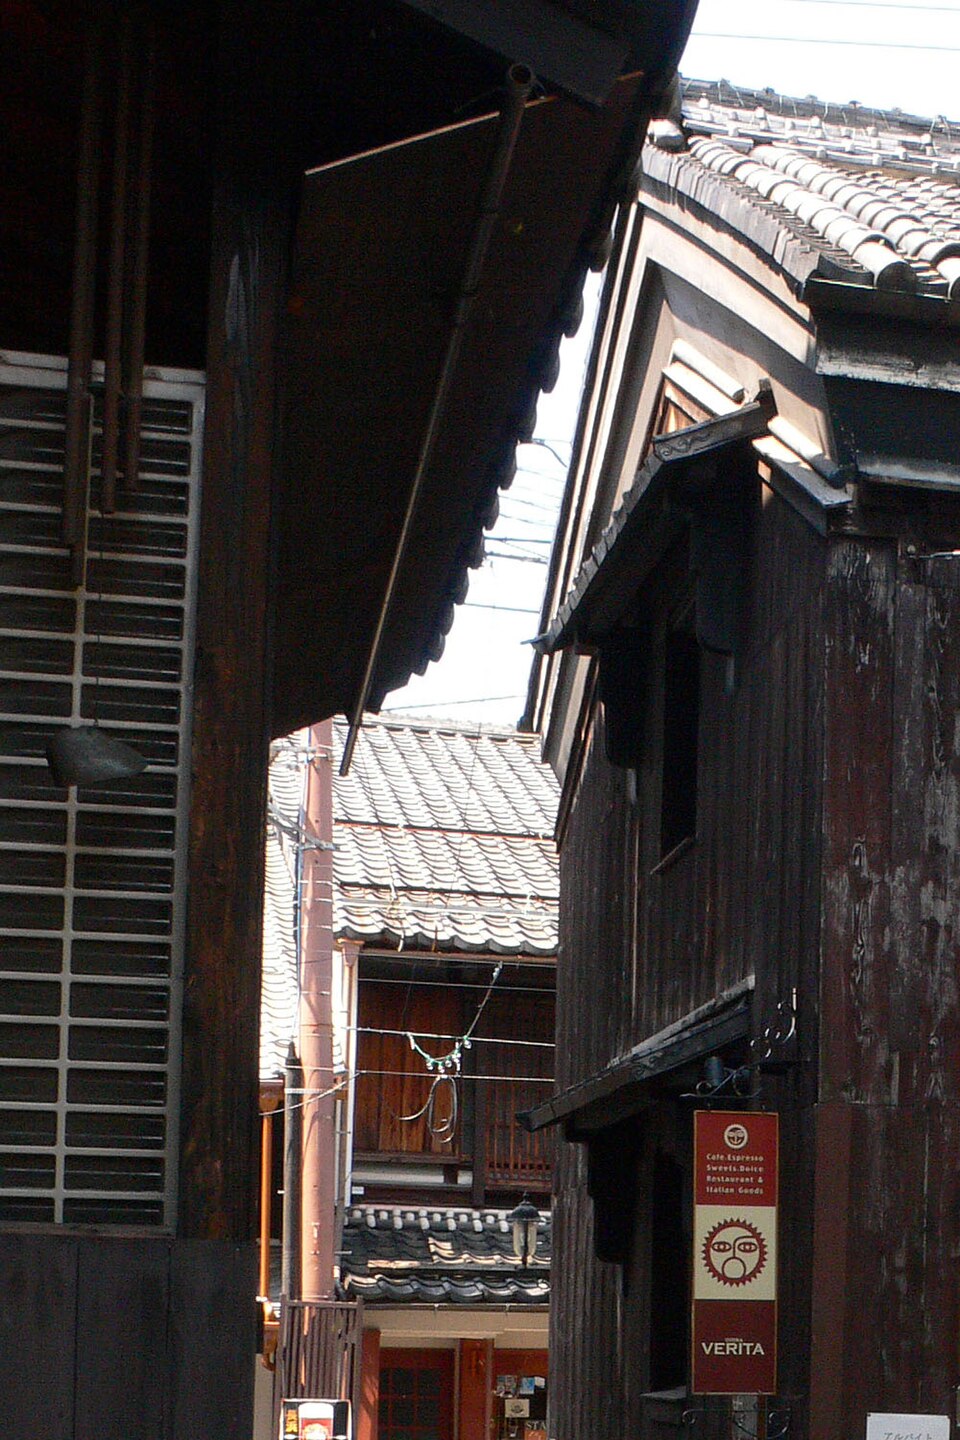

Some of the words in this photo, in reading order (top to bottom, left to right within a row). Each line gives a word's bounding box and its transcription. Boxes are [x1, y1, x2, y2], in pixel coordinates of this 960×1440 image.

[706, 1175, 754, 1184] Restaurant
[738, 1186, 764, 1194] Goods
[701, 1342, 765, 1355] VERITA
